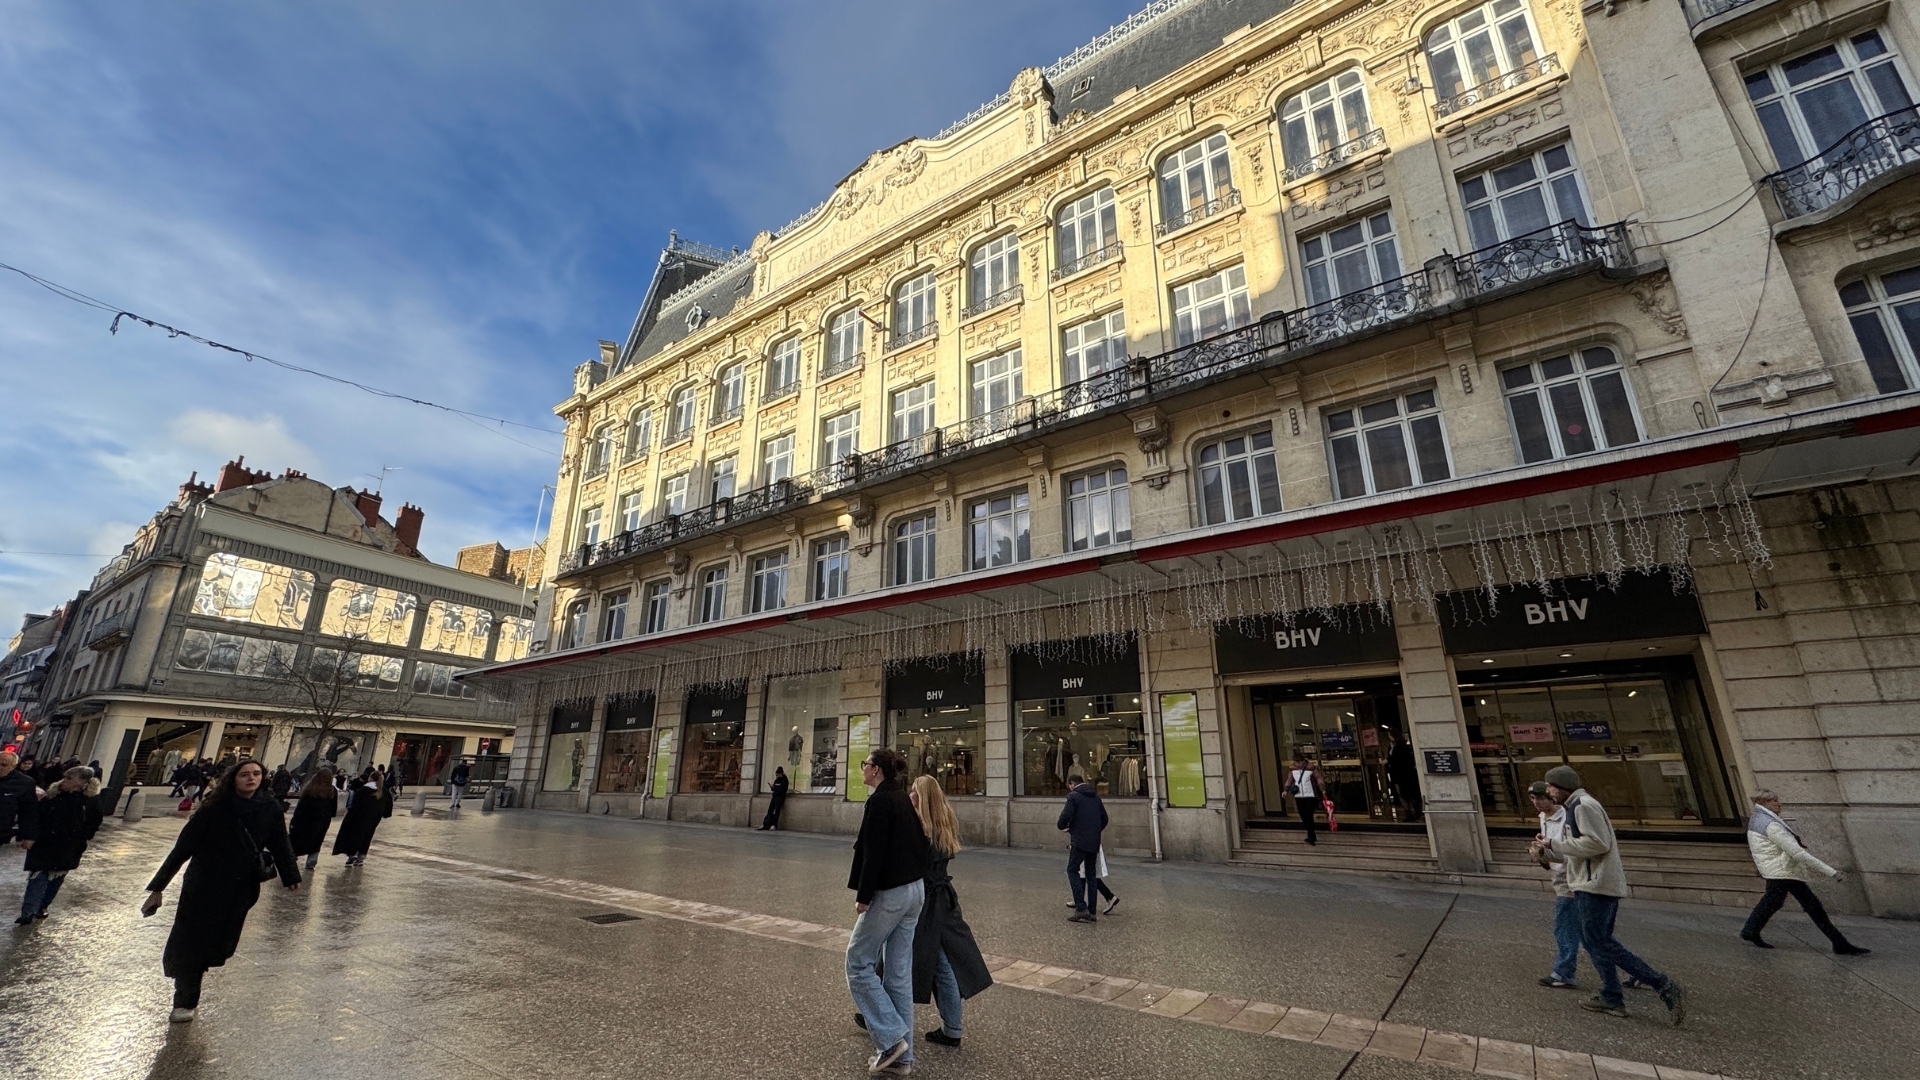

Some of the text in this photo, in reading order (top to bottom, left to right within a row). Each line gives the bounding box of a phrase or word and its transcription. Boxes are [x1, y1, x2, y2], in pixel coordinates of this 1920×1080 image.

[786, 148, 994, 273] GALERIES LAFAYETTE
[1523, 598, 1588, 625] BHV
[1275, 627, 1321, 649] BHV
[1062, 677, 1084, 689] BHV
[926, 690, 944, 700] BHV
[711, 708, 724, 717] BHV
